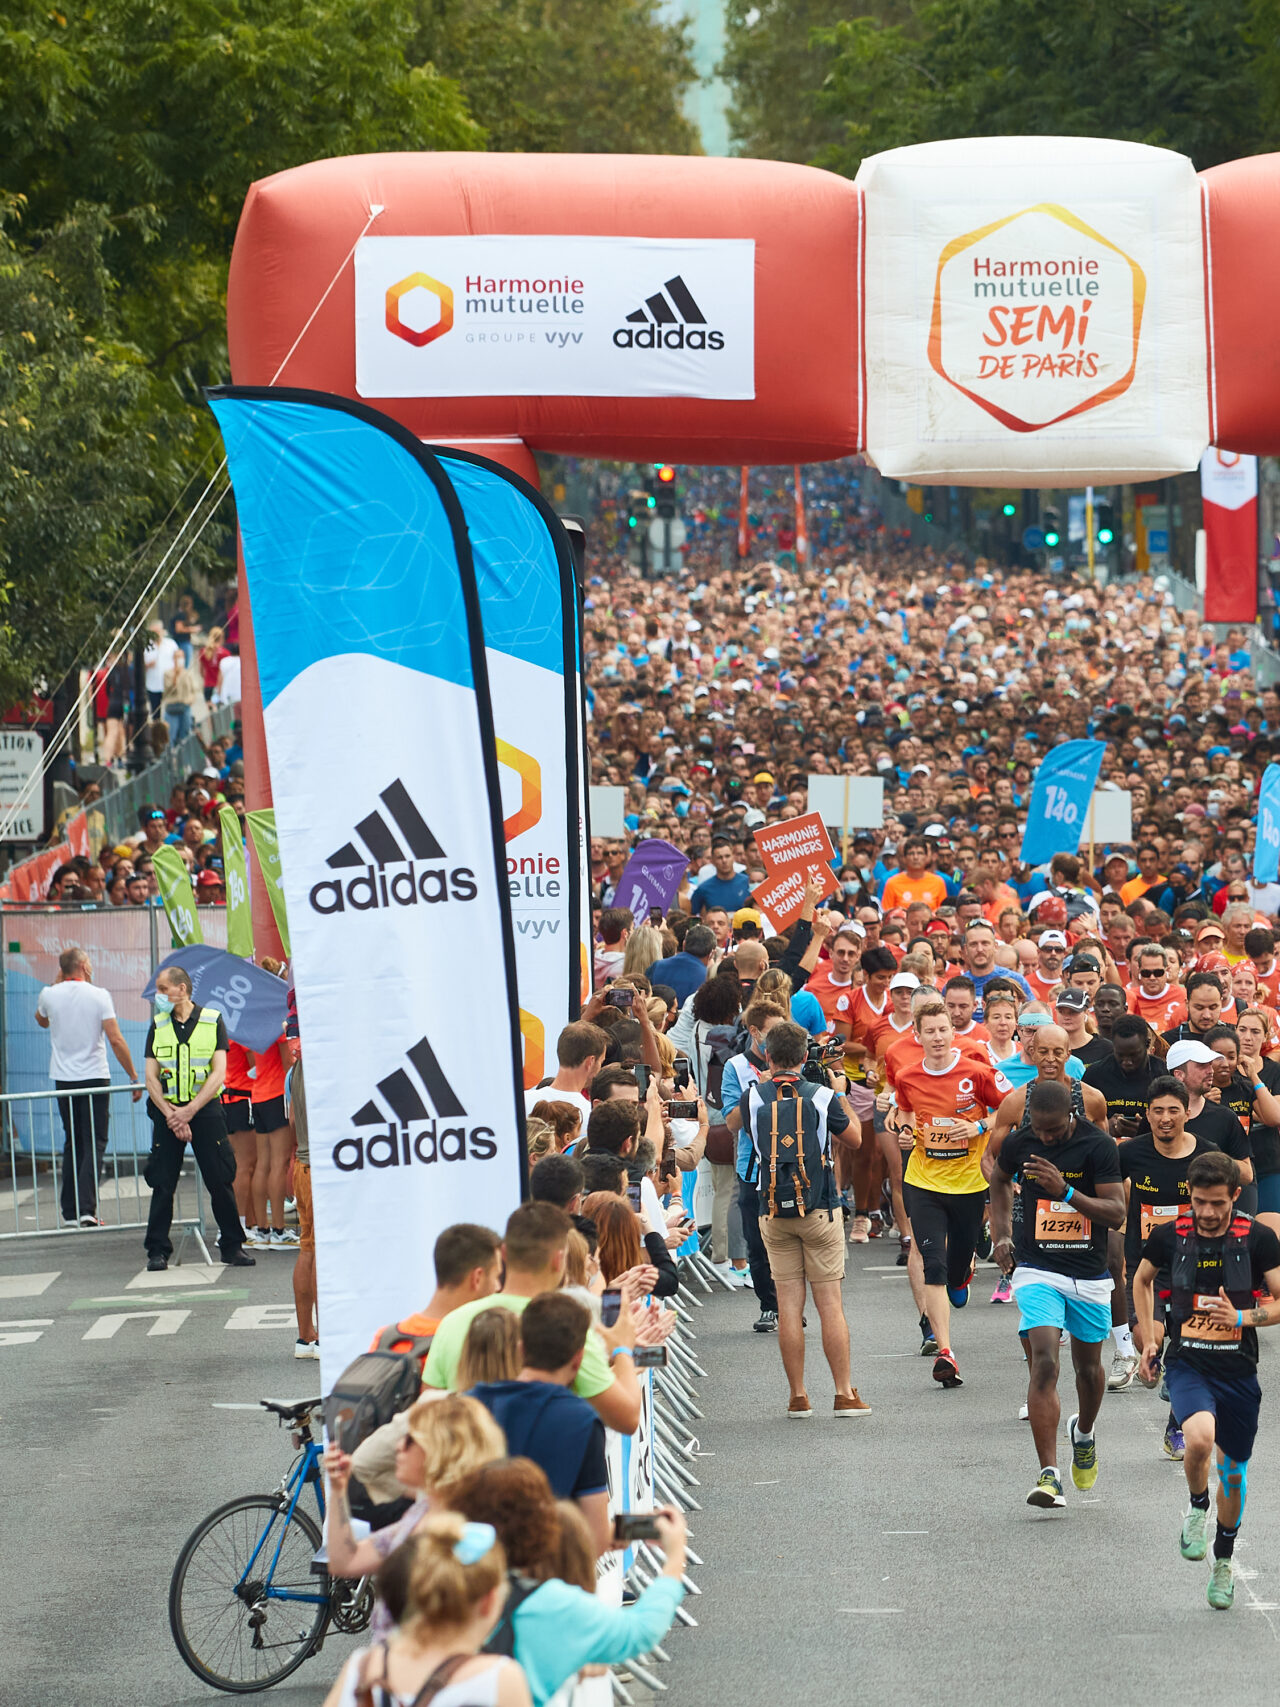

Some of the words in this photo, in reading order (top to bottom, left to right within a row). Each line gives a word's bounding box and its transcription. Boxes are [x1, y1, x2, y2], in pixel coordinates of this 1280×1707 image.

[974, 257, 1099, 277] Harmonie
[465, 275, 584, 294] Harmonie
[974, 278, 1099, 297] mutuelle
[465, 295, 584, 314] mutuelle
[465, 332, 536, 344] GROUPE
[544, 330, 583, 348] vyv
[613, 322, 725, 351] adidas
[976, 355, 1014, 379] DE
[505, 852, 560, 875] onie
[771, 839, 824, 865] RUNNERS
[309, 861, 478, 915] adidas
[508, 875, 560, 898] elle
[332, 1119, 498, 1171] adidas
[1041, 1220, 1082, 1232] 12374
